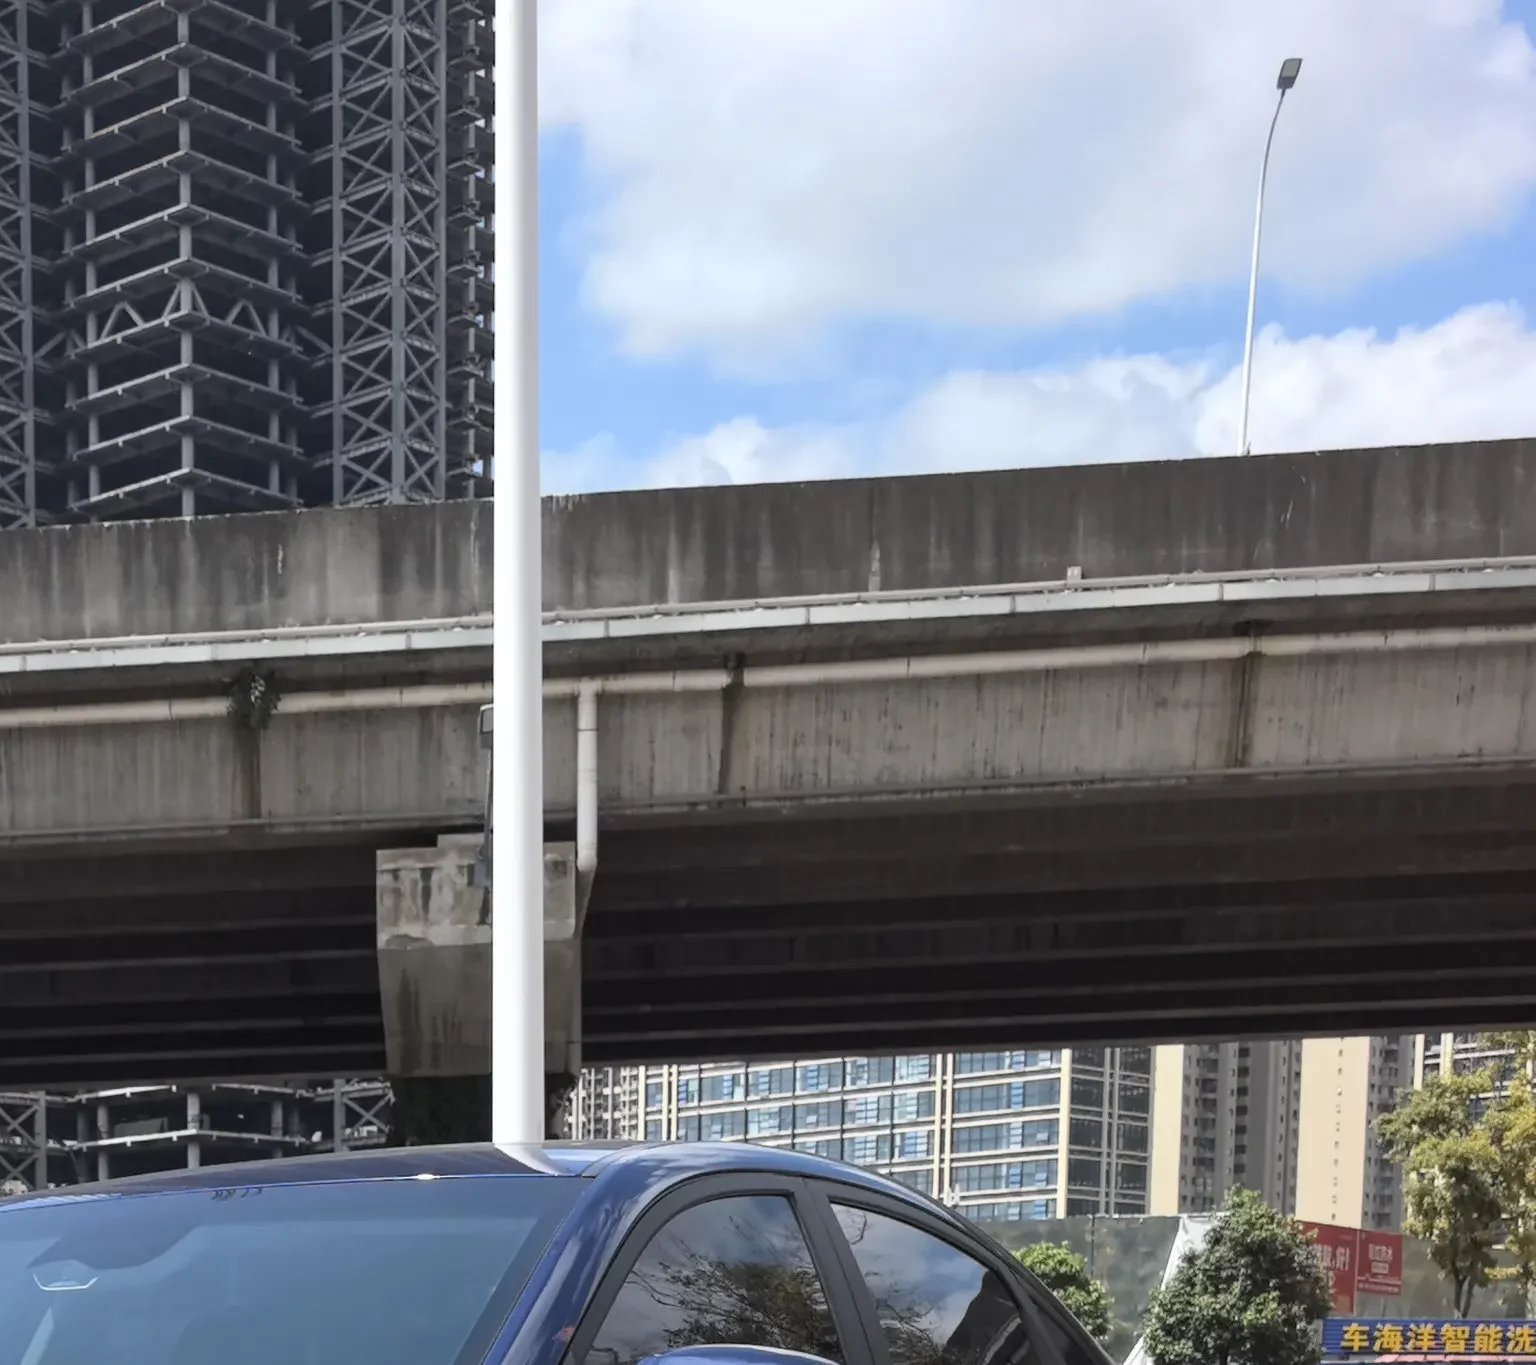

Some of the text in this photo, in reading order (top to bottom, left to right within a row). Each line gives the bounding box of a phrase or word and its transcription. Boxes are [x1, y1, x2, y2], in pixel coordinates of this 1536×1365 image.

[1340, 1322, 1536, 1353] 车海洋智能洗
